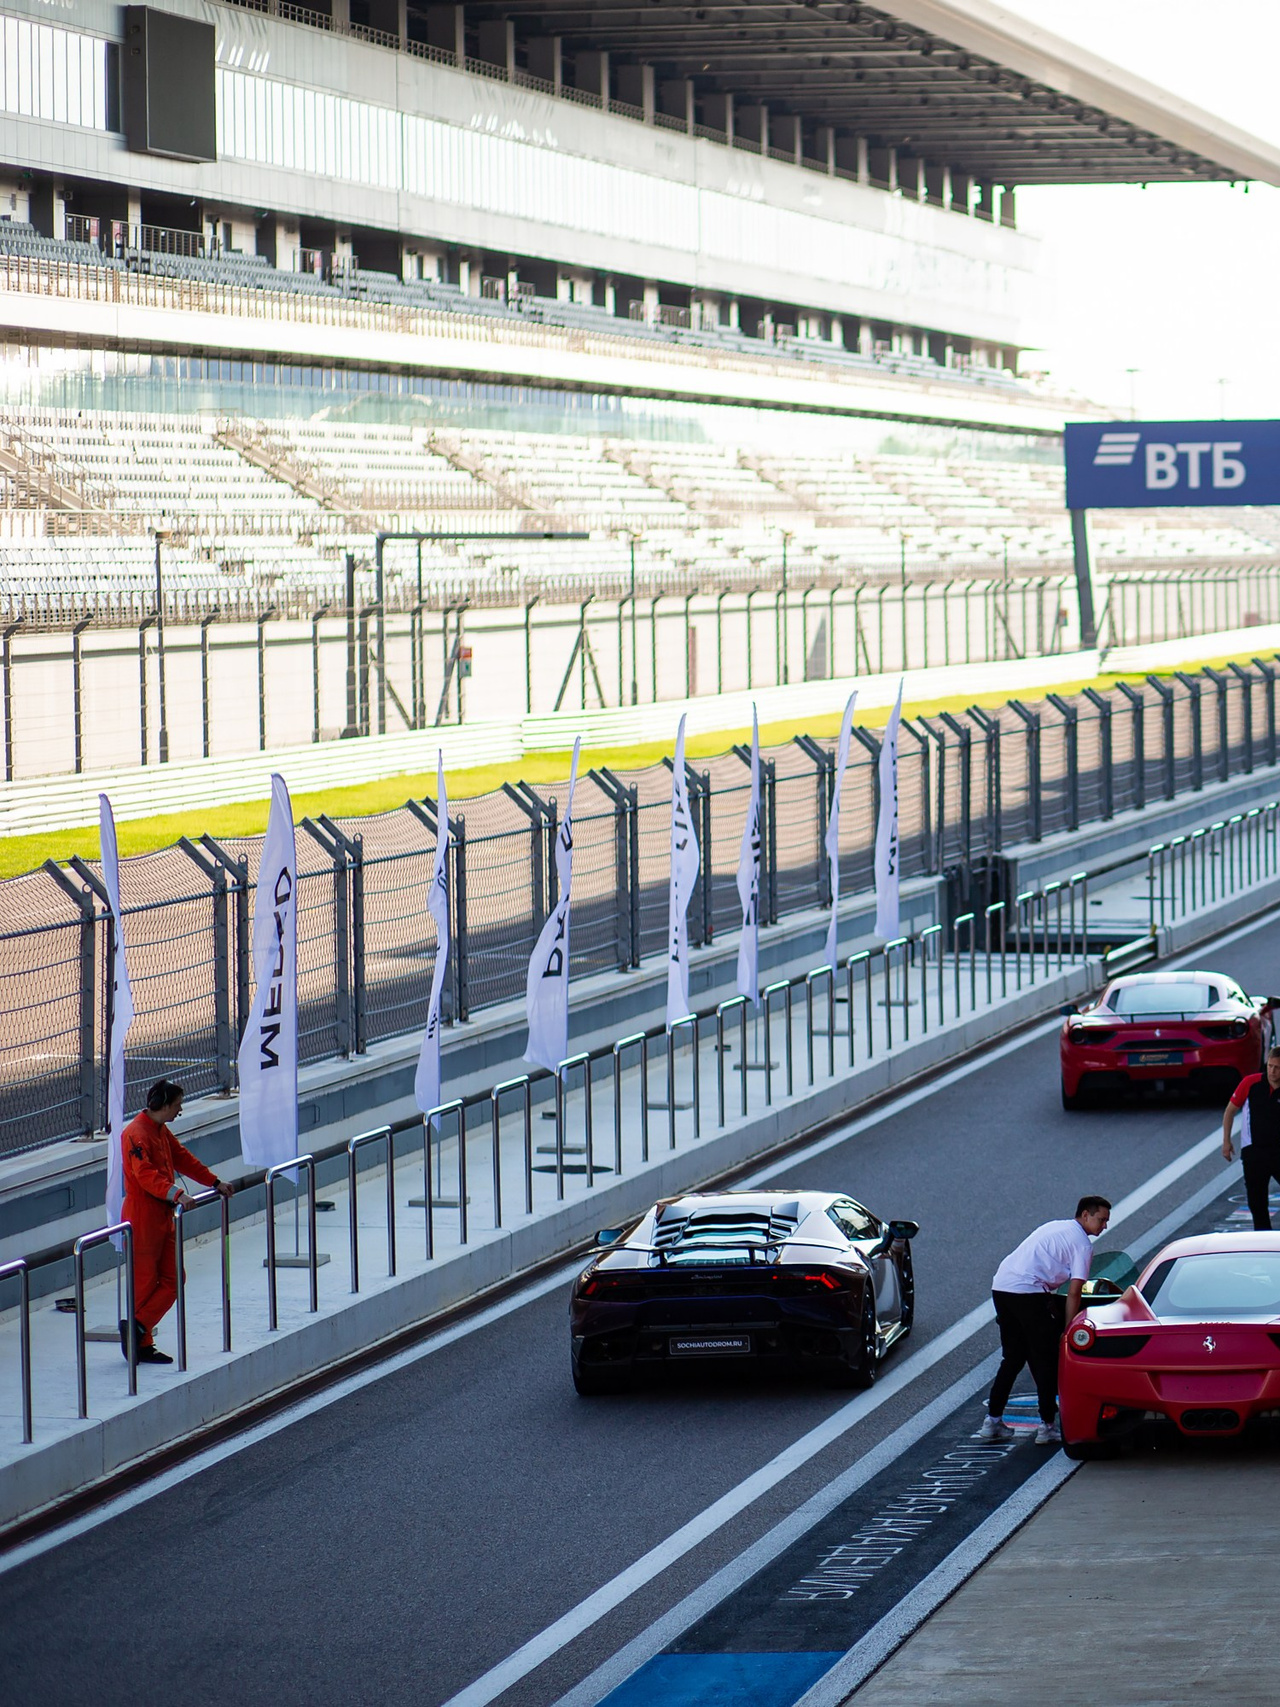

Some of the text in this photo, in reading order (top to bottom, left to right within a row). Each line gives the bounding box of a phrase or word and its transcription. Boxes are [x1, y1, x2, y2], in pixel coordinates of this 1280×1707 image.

[1145, 441, 1246, 489] ВТБ
[677, 1340, 743, 1349] SOCHIAUTODROM.RU
[779, 1444, 1016, 1601] ГОНОЧНАЯ АКАДЕМИЯ
